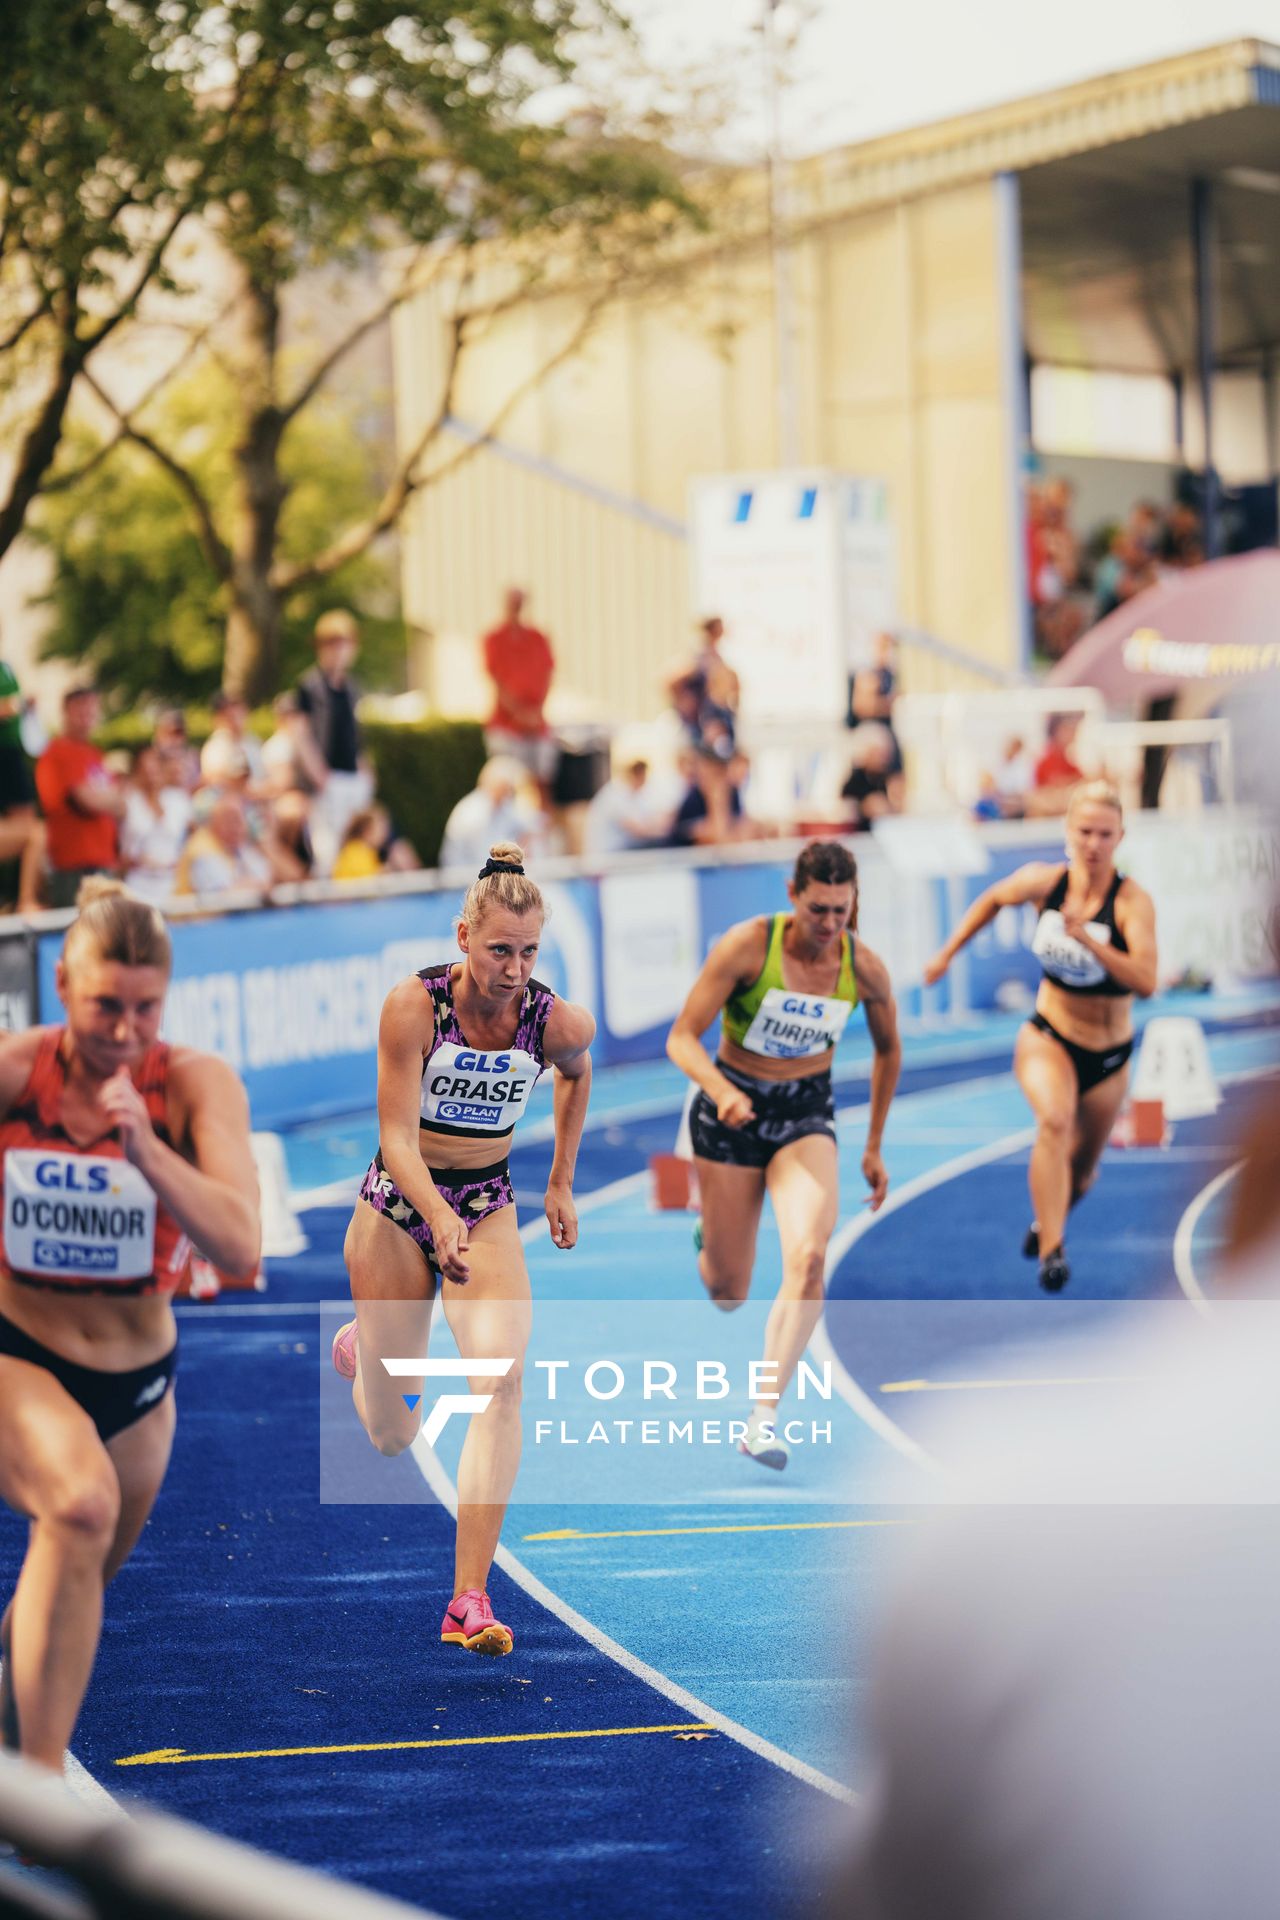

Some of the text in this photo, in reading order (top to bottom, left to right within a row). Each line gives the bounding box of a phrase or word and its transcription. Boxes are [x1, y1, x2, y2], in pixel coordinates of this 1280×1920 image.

[430, 1075, 526, 1103] CRASE
[463, 1106, 499, 1118] PLAN
[12, 1197, 145, 1239] O'CONNOR
